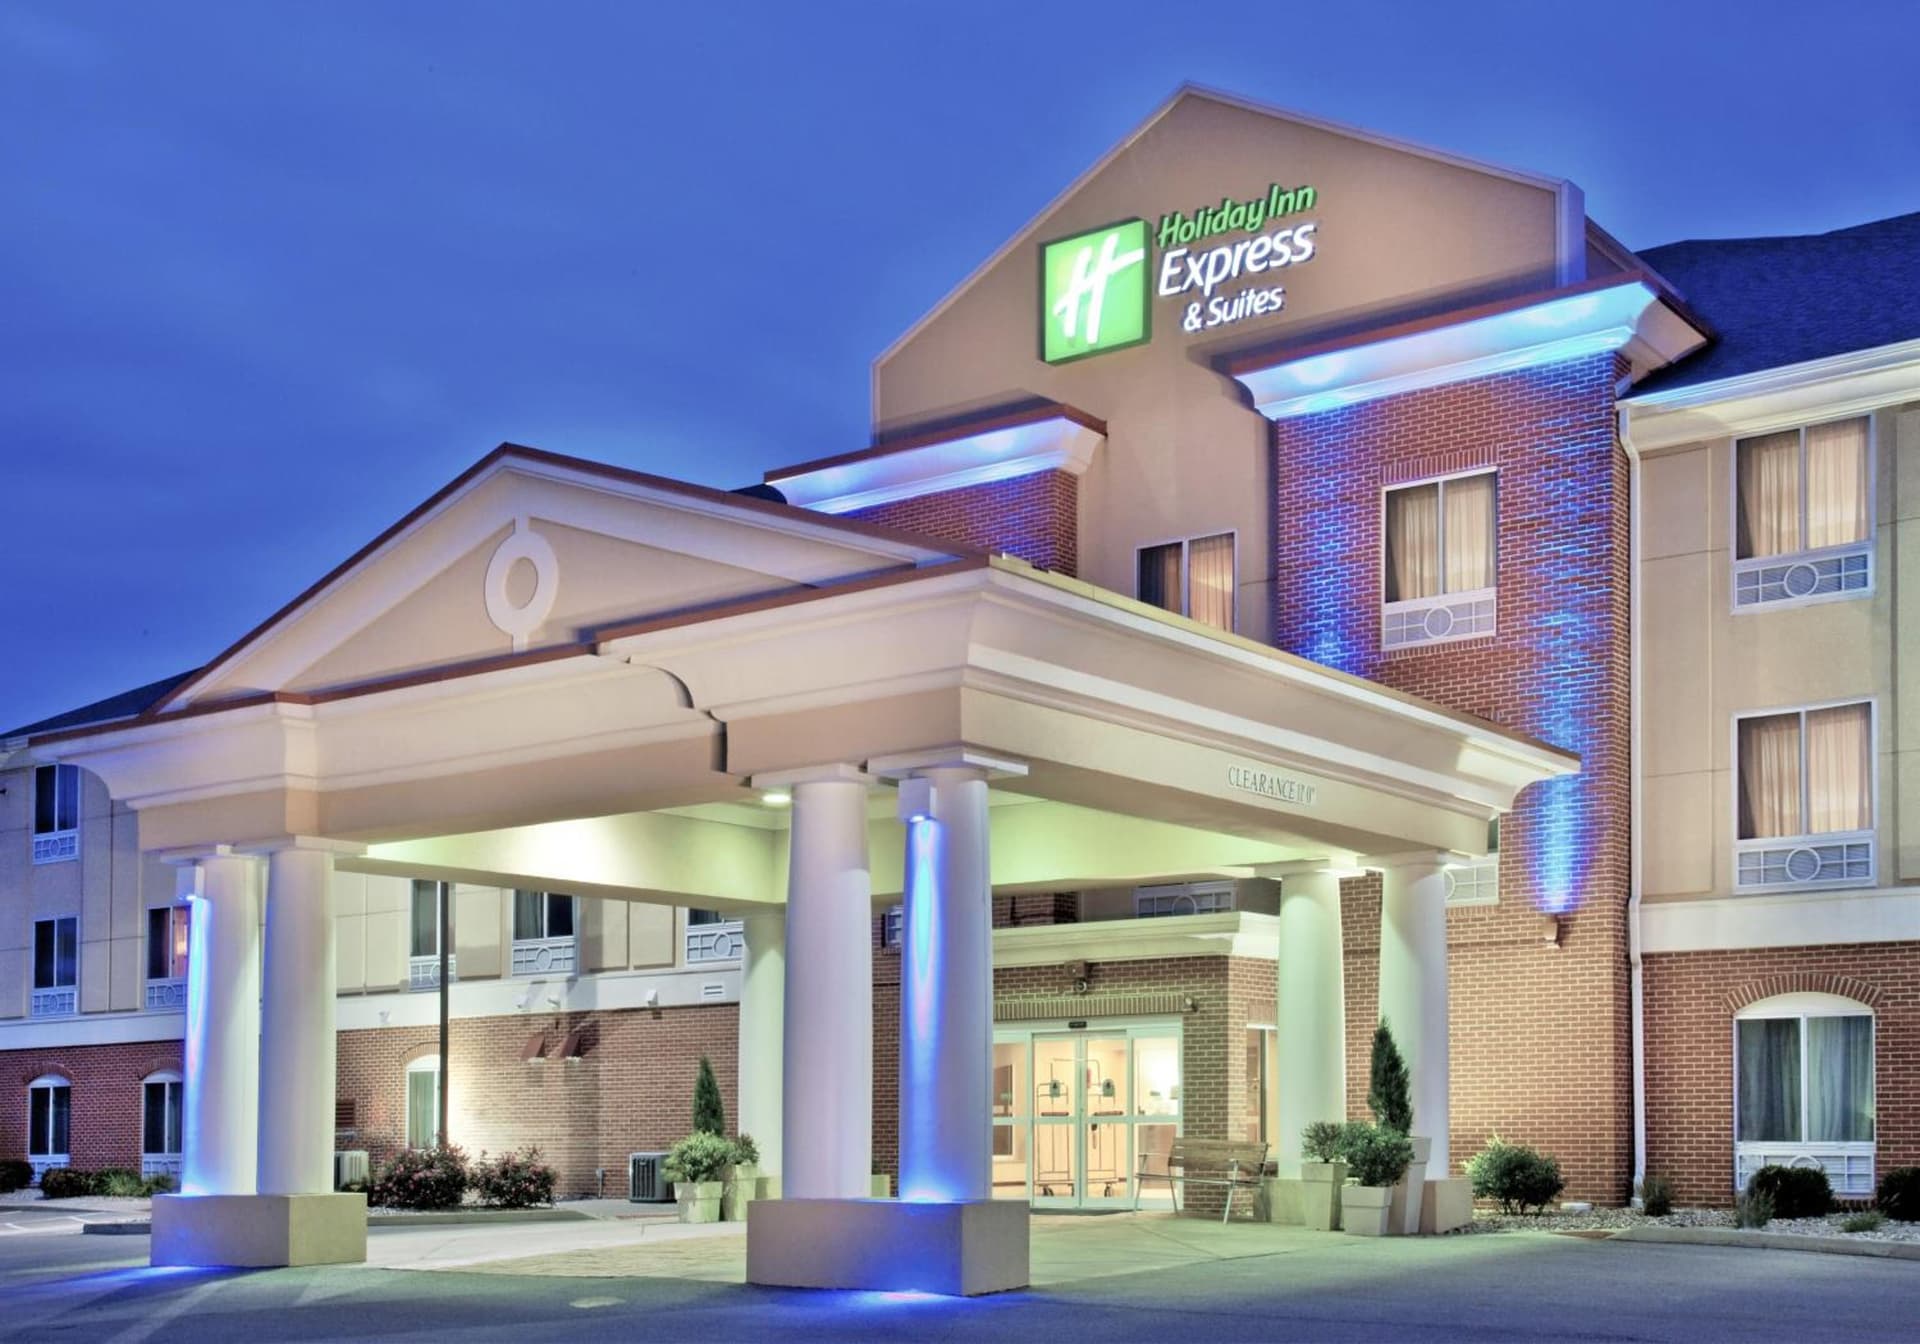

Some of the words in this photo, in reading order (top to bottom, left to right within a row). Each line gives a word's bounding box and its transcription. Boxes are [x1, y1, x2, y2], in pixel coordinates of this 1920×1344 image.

[1158, 199, 1266, 248] Holiday
[1267, 184, 1316, 219] Inn
[1158, 223, 1316, 297] Express
[1183, 302, 1202, 332] &
[1206, 287, 1284, 327] Suites
[1228, 766, 1295, 800] CLEARANCE
